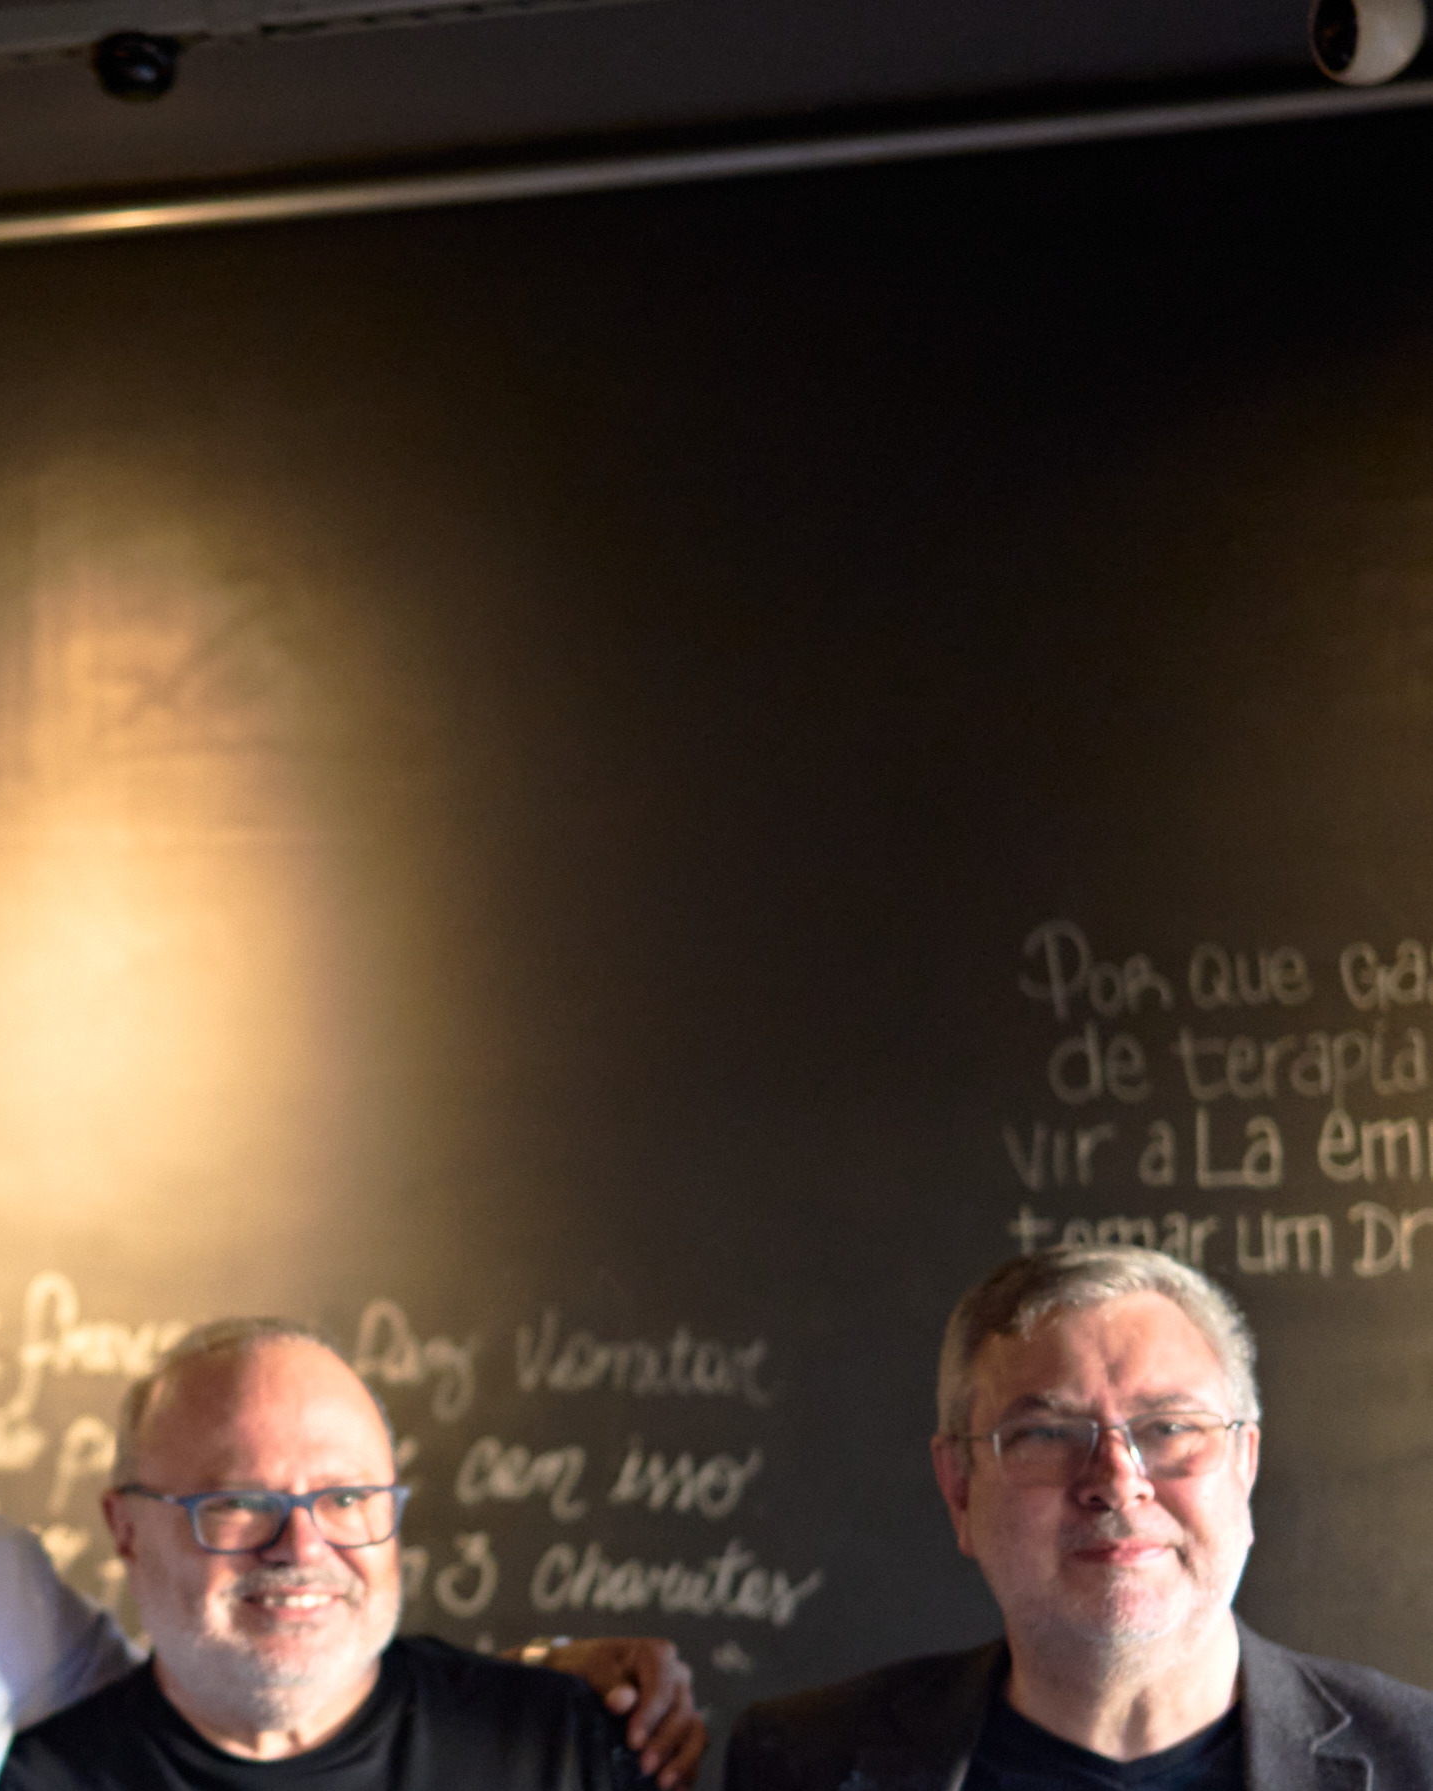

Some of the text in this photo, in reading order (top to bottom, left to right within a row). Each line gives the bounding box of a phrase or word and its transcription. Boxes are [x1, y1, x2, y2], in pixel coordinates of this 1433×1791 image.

[1047, 1020, 1428, 1112] de terapia
[1235, 1210, 1333, 1277] um
